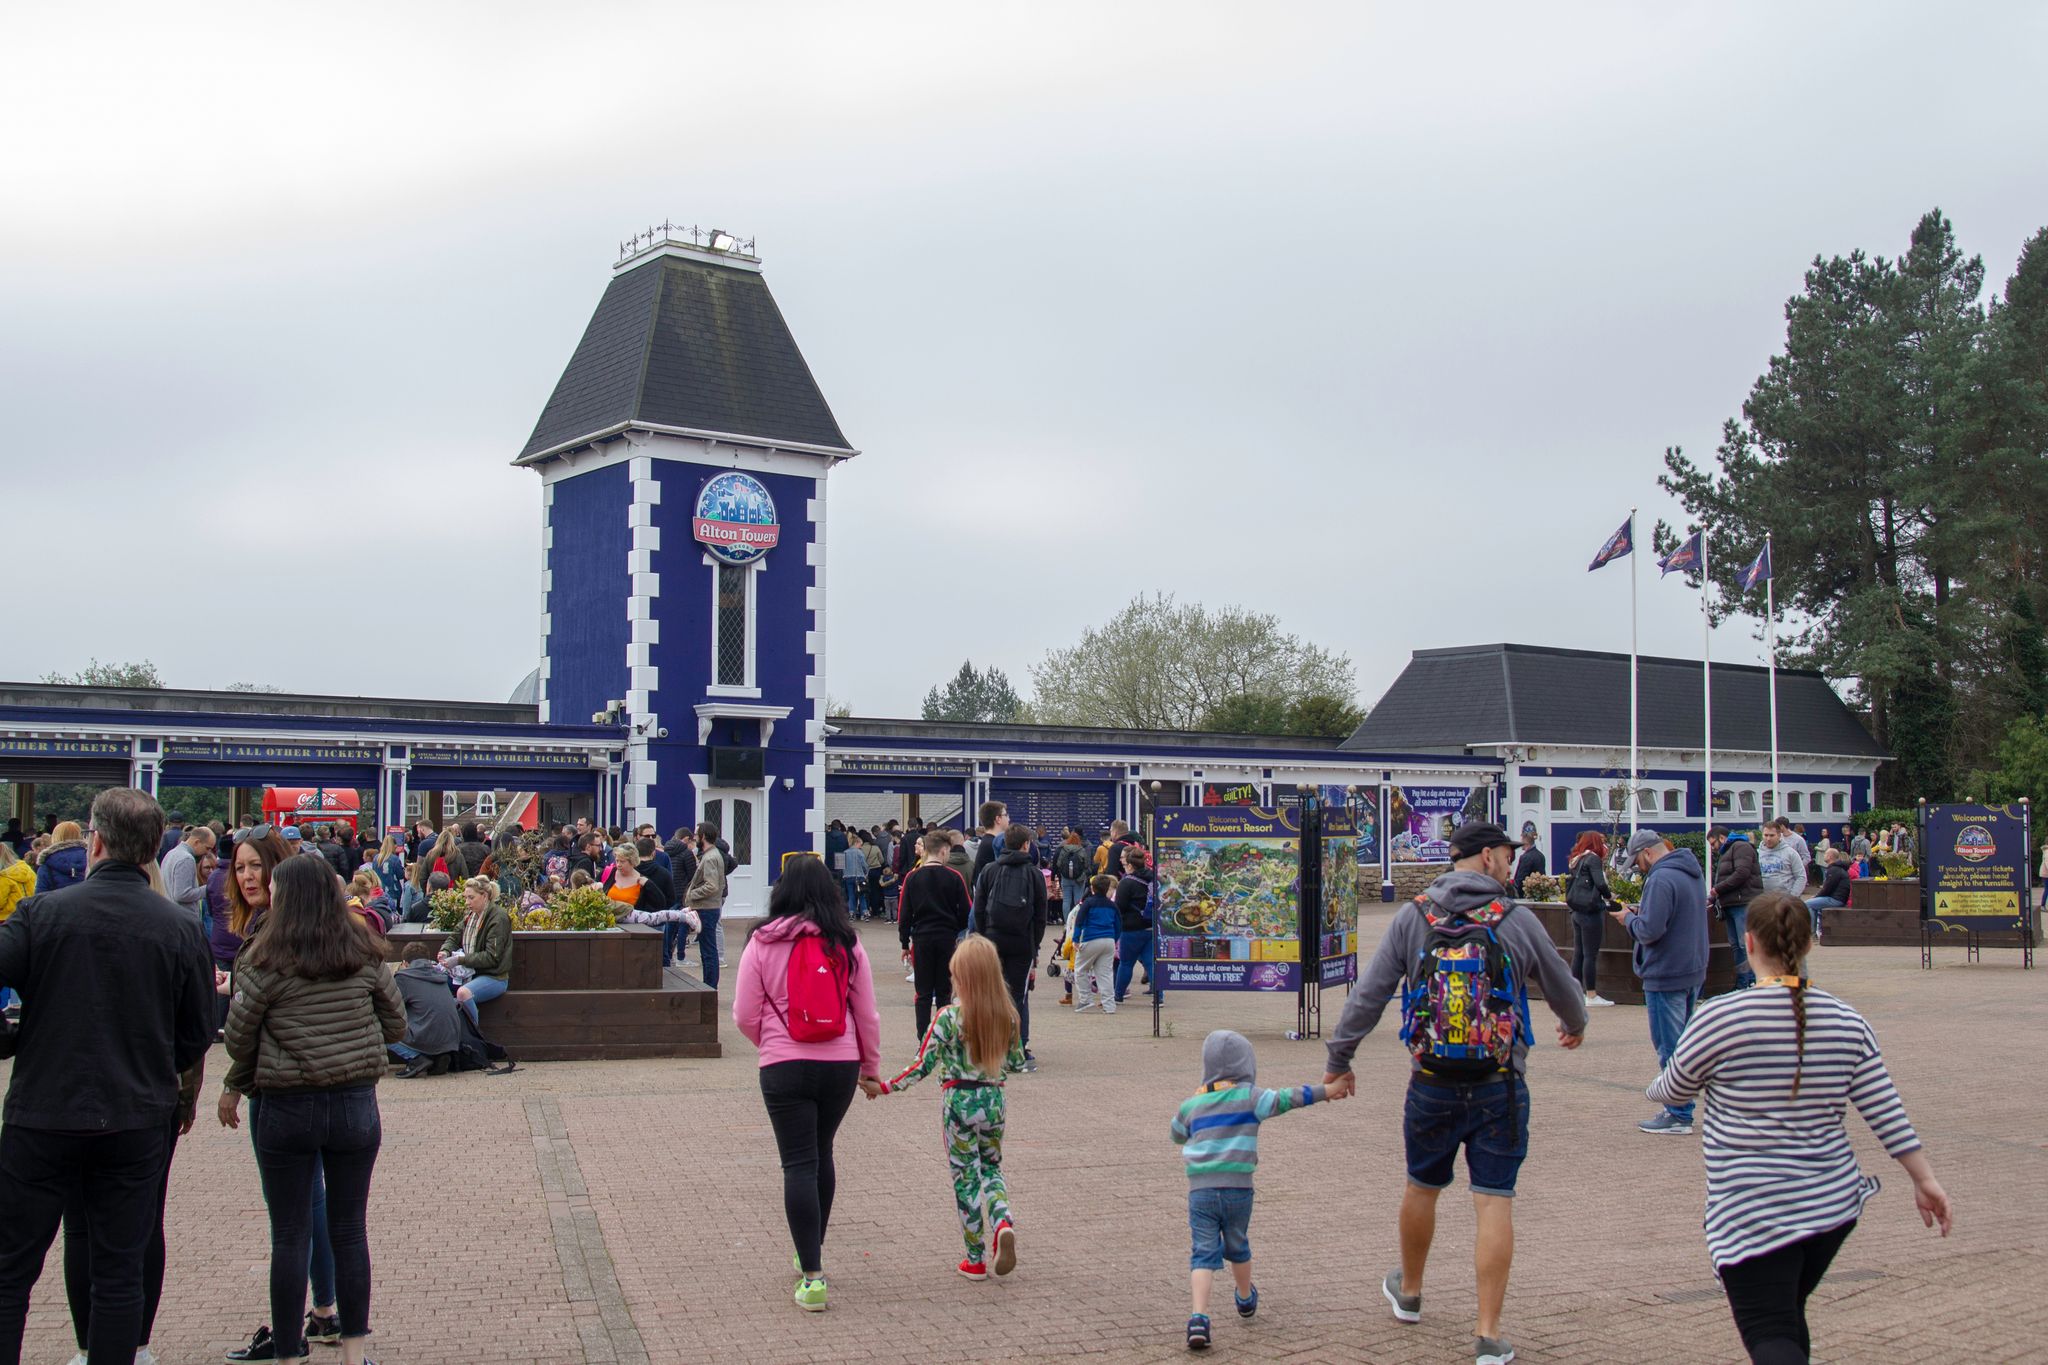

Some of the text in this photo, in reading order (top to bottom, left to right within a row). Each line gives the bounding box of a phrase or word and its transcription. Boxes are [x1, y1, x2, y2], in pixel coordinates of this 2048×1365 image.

[700, 523, 776, 543] Alton Towers
[54, 742, 118, 752] TICKETS
[236, 747, 370, 758] ALL OTHER TICKETS
[494, 754, 531, 762] OTHER
[535, 755, 579, 764] TICKETS
[1224, 784, 1252, 802] GUILTY!
[1952, 814, 1987, 822] Welcome
[1182, 822, 1273, 832] Alton Towers Resort
[1939, 880, 1963, 888] straight
[1168, 963, 1178, 972] Pay
[1194, 964, 1205, 972] day
[1170, 972, 1180, 981] all
